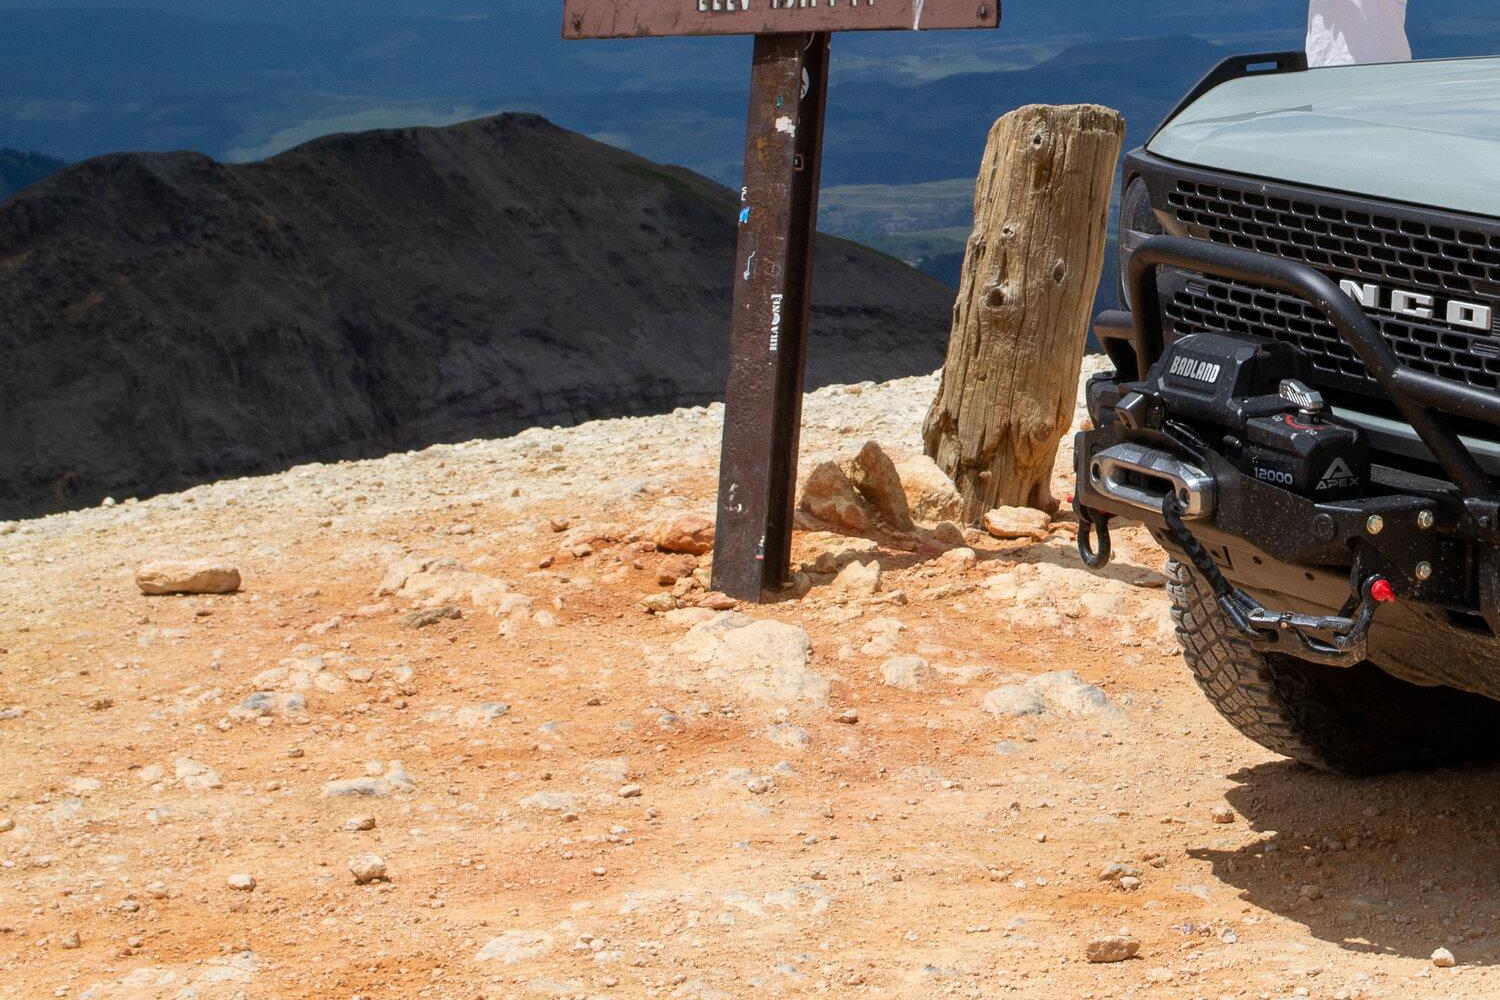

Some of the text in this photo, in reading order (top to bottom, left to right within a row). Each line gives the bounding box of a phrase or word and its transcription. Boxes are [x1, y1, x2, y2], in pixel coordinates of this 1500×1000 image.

[1339, 279, 1492, 331] NCO
[1169, 355, 1221, 383] BADLAND
[1254, 466, 1293, 485] 12000
[1315, 477, 1360, 490] APEX
